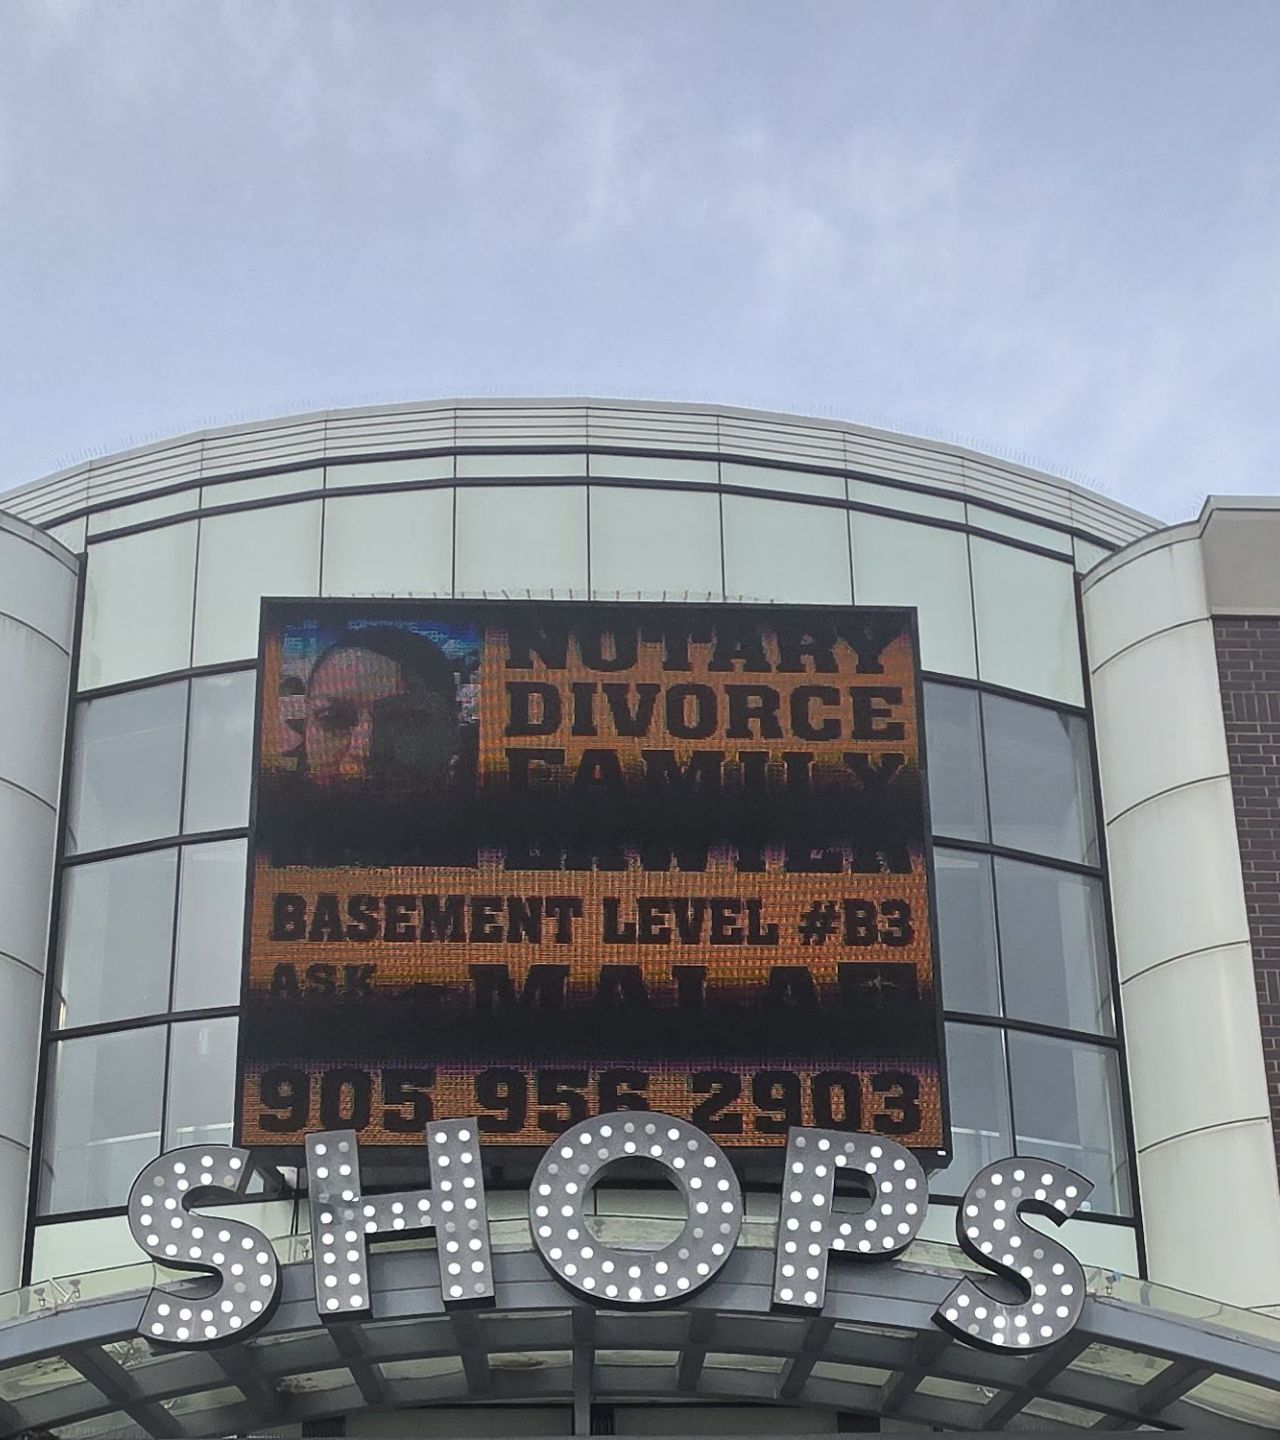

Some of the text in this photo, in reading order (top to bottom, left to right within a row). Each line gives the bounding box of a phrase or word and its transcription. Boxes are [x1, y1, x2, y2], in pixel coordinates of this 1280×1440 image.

[506, 682, 907, 741] DIVORCE
[272, 895, 915, 947] BASEMENT LEVEL #B3
[272, 963, 377, 998] ASK
[260, 1067, 920, 1135] 905 956 2903
[128, 1109, 1095, 1351] SHOPS
